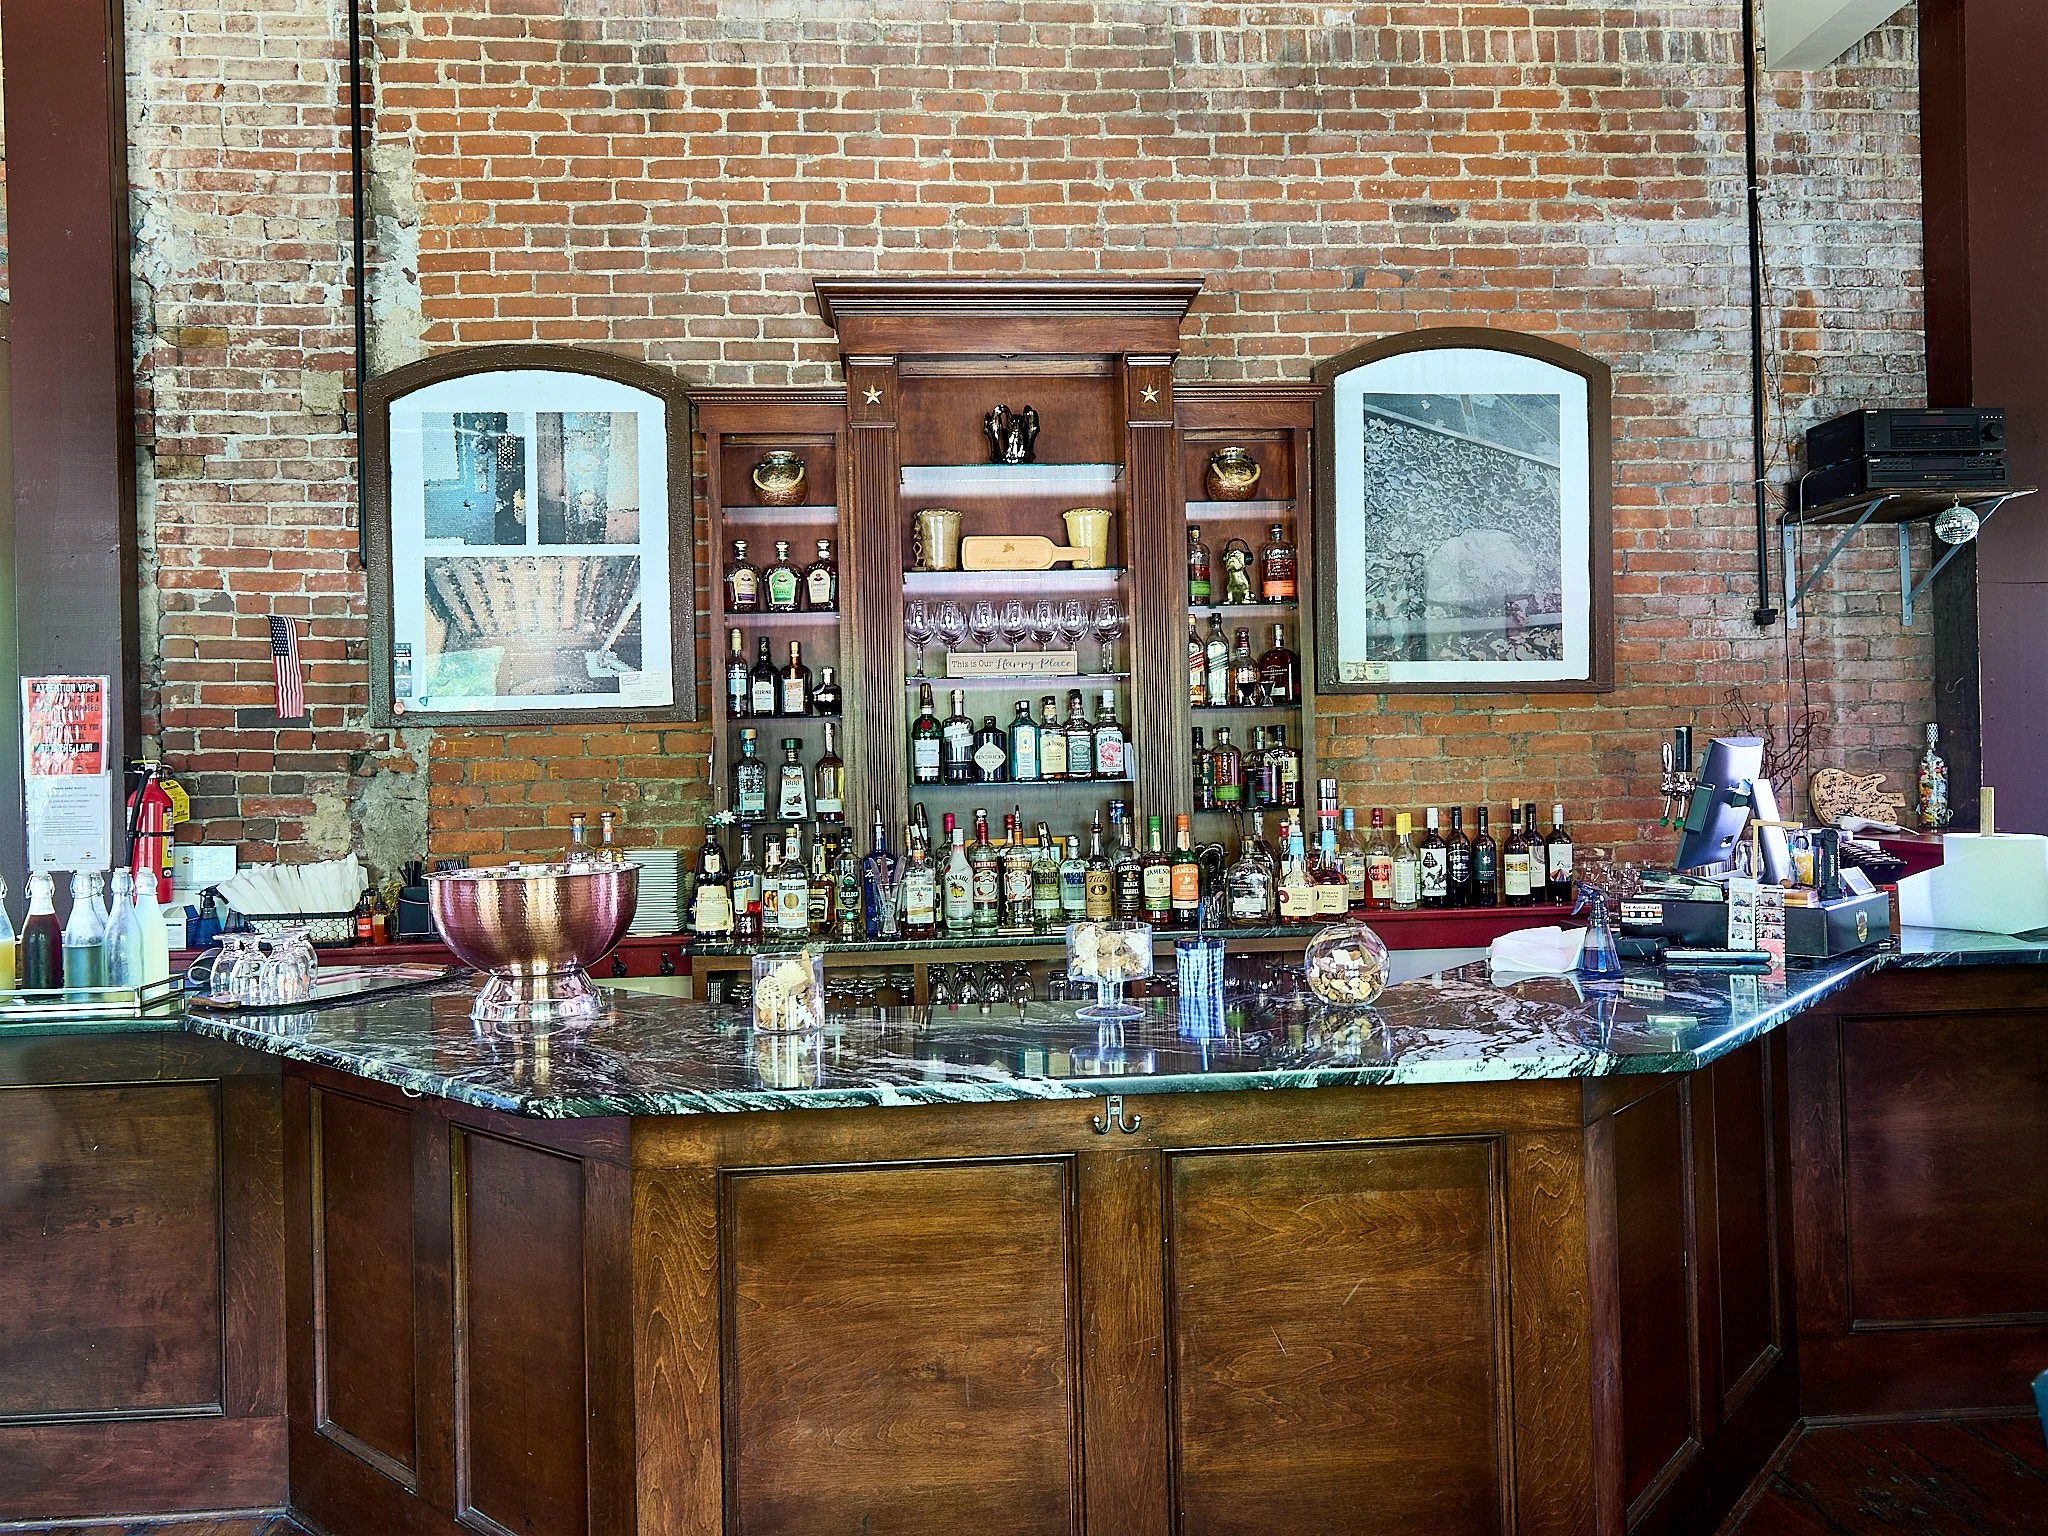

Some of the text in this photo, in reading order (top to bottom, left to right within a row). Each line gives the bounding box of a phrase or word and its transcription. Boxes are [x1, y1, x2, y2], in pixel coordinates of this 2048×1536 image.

[951, 657, 1072, 671] This is Our Happy Place
[1063, 871, 1086, 879] ABSOLU
[1146, 867, 1170, 877] JAMESO
